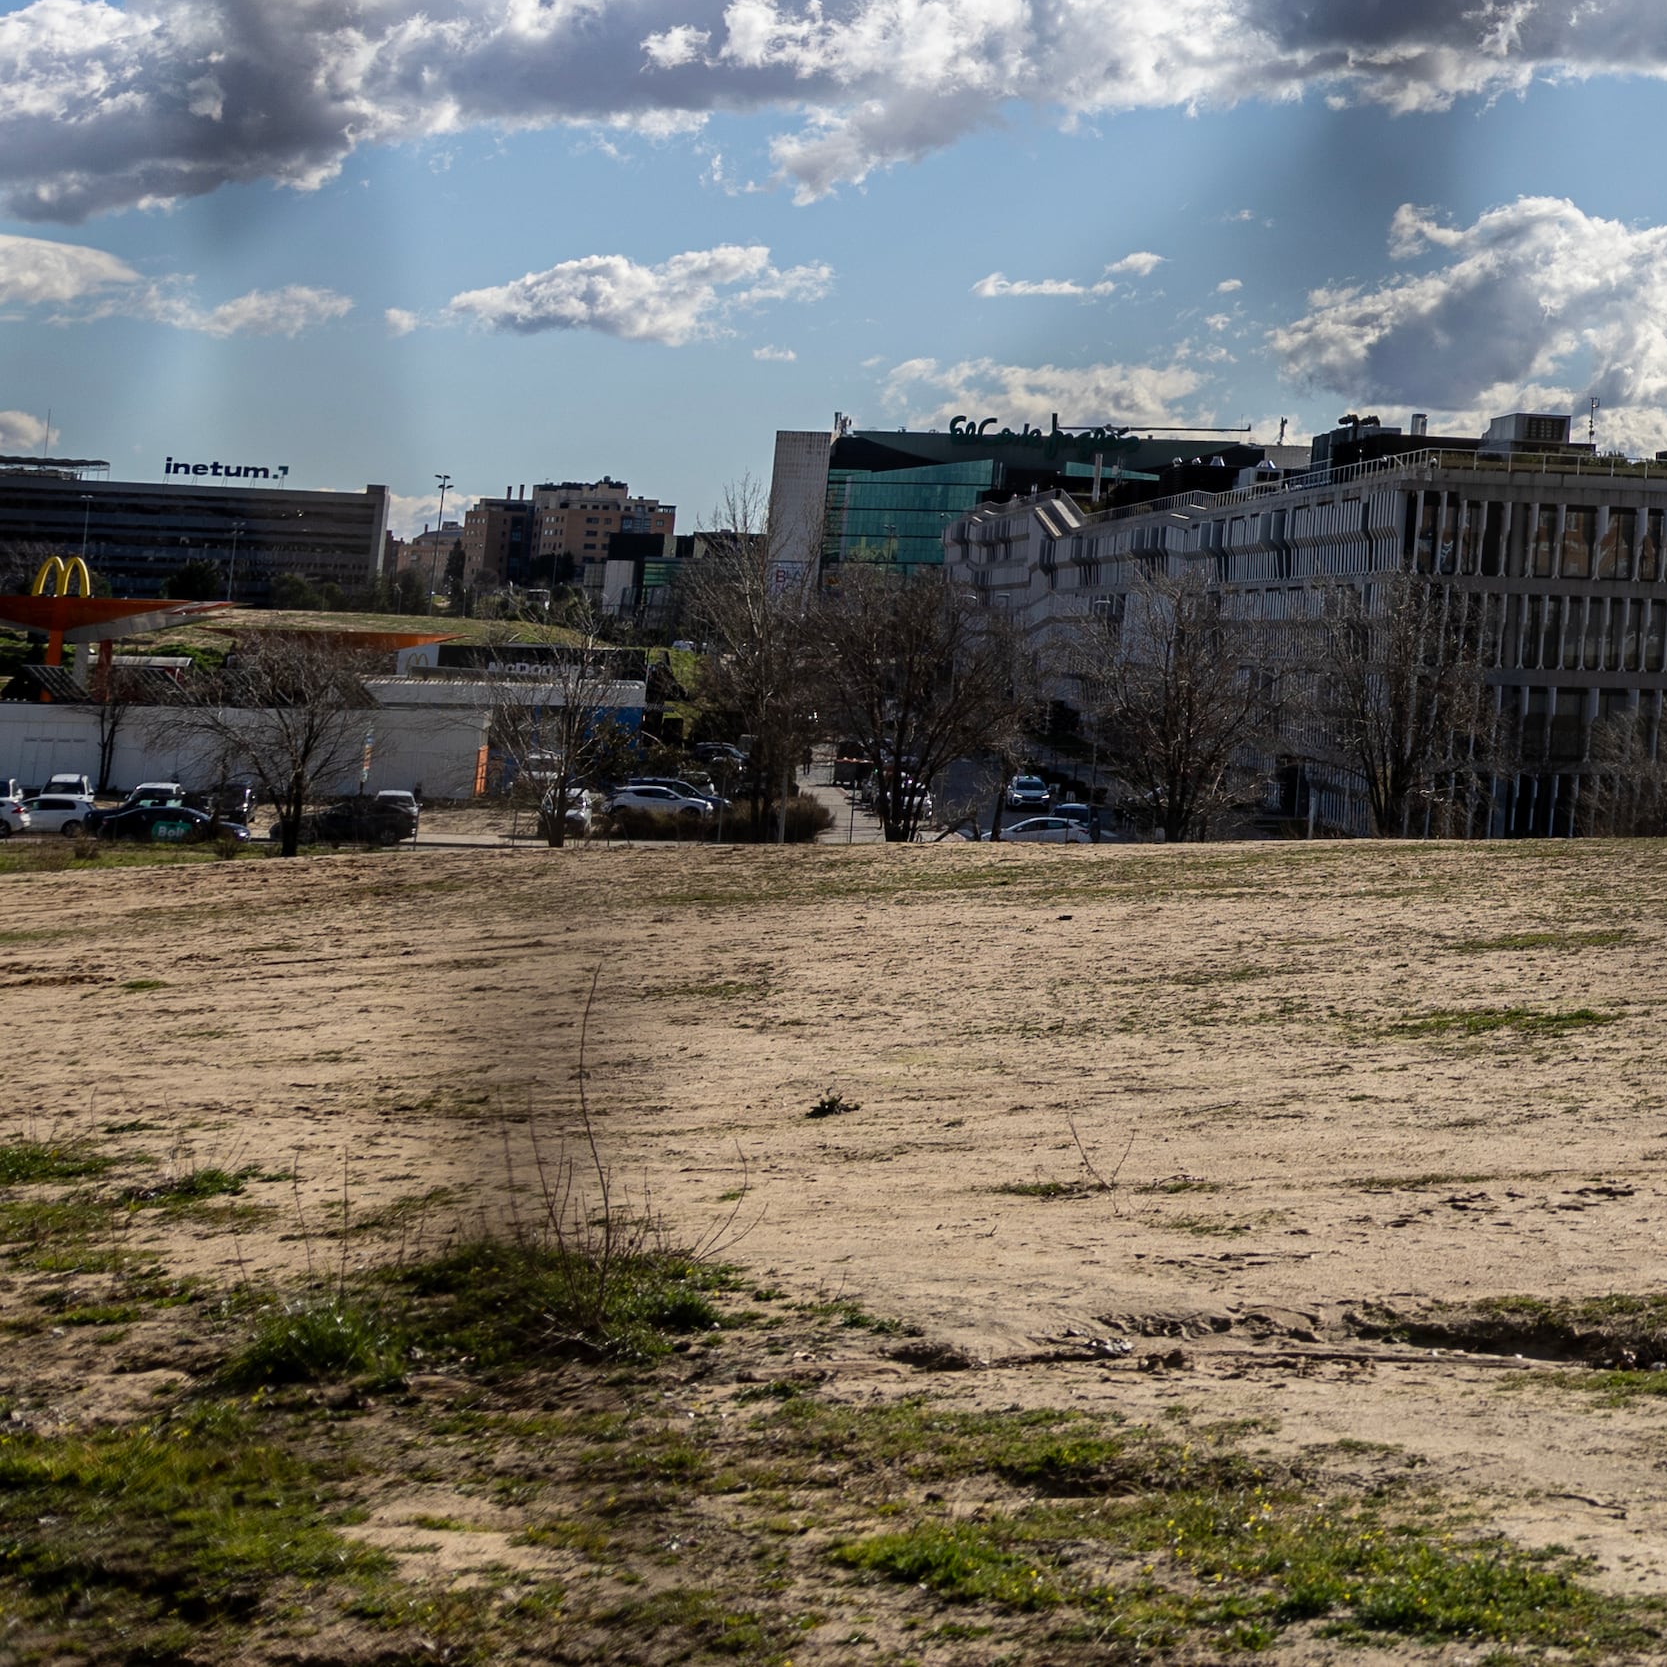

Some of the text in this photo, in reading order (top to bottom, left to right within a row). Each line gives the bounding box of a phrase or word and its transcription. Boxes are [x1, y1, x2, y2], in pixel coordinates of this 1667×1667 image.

[949, 415, 977, 445] El
[487, 661, 595, 678] McDonlds
[157, 825, 185, 837] Bolt
